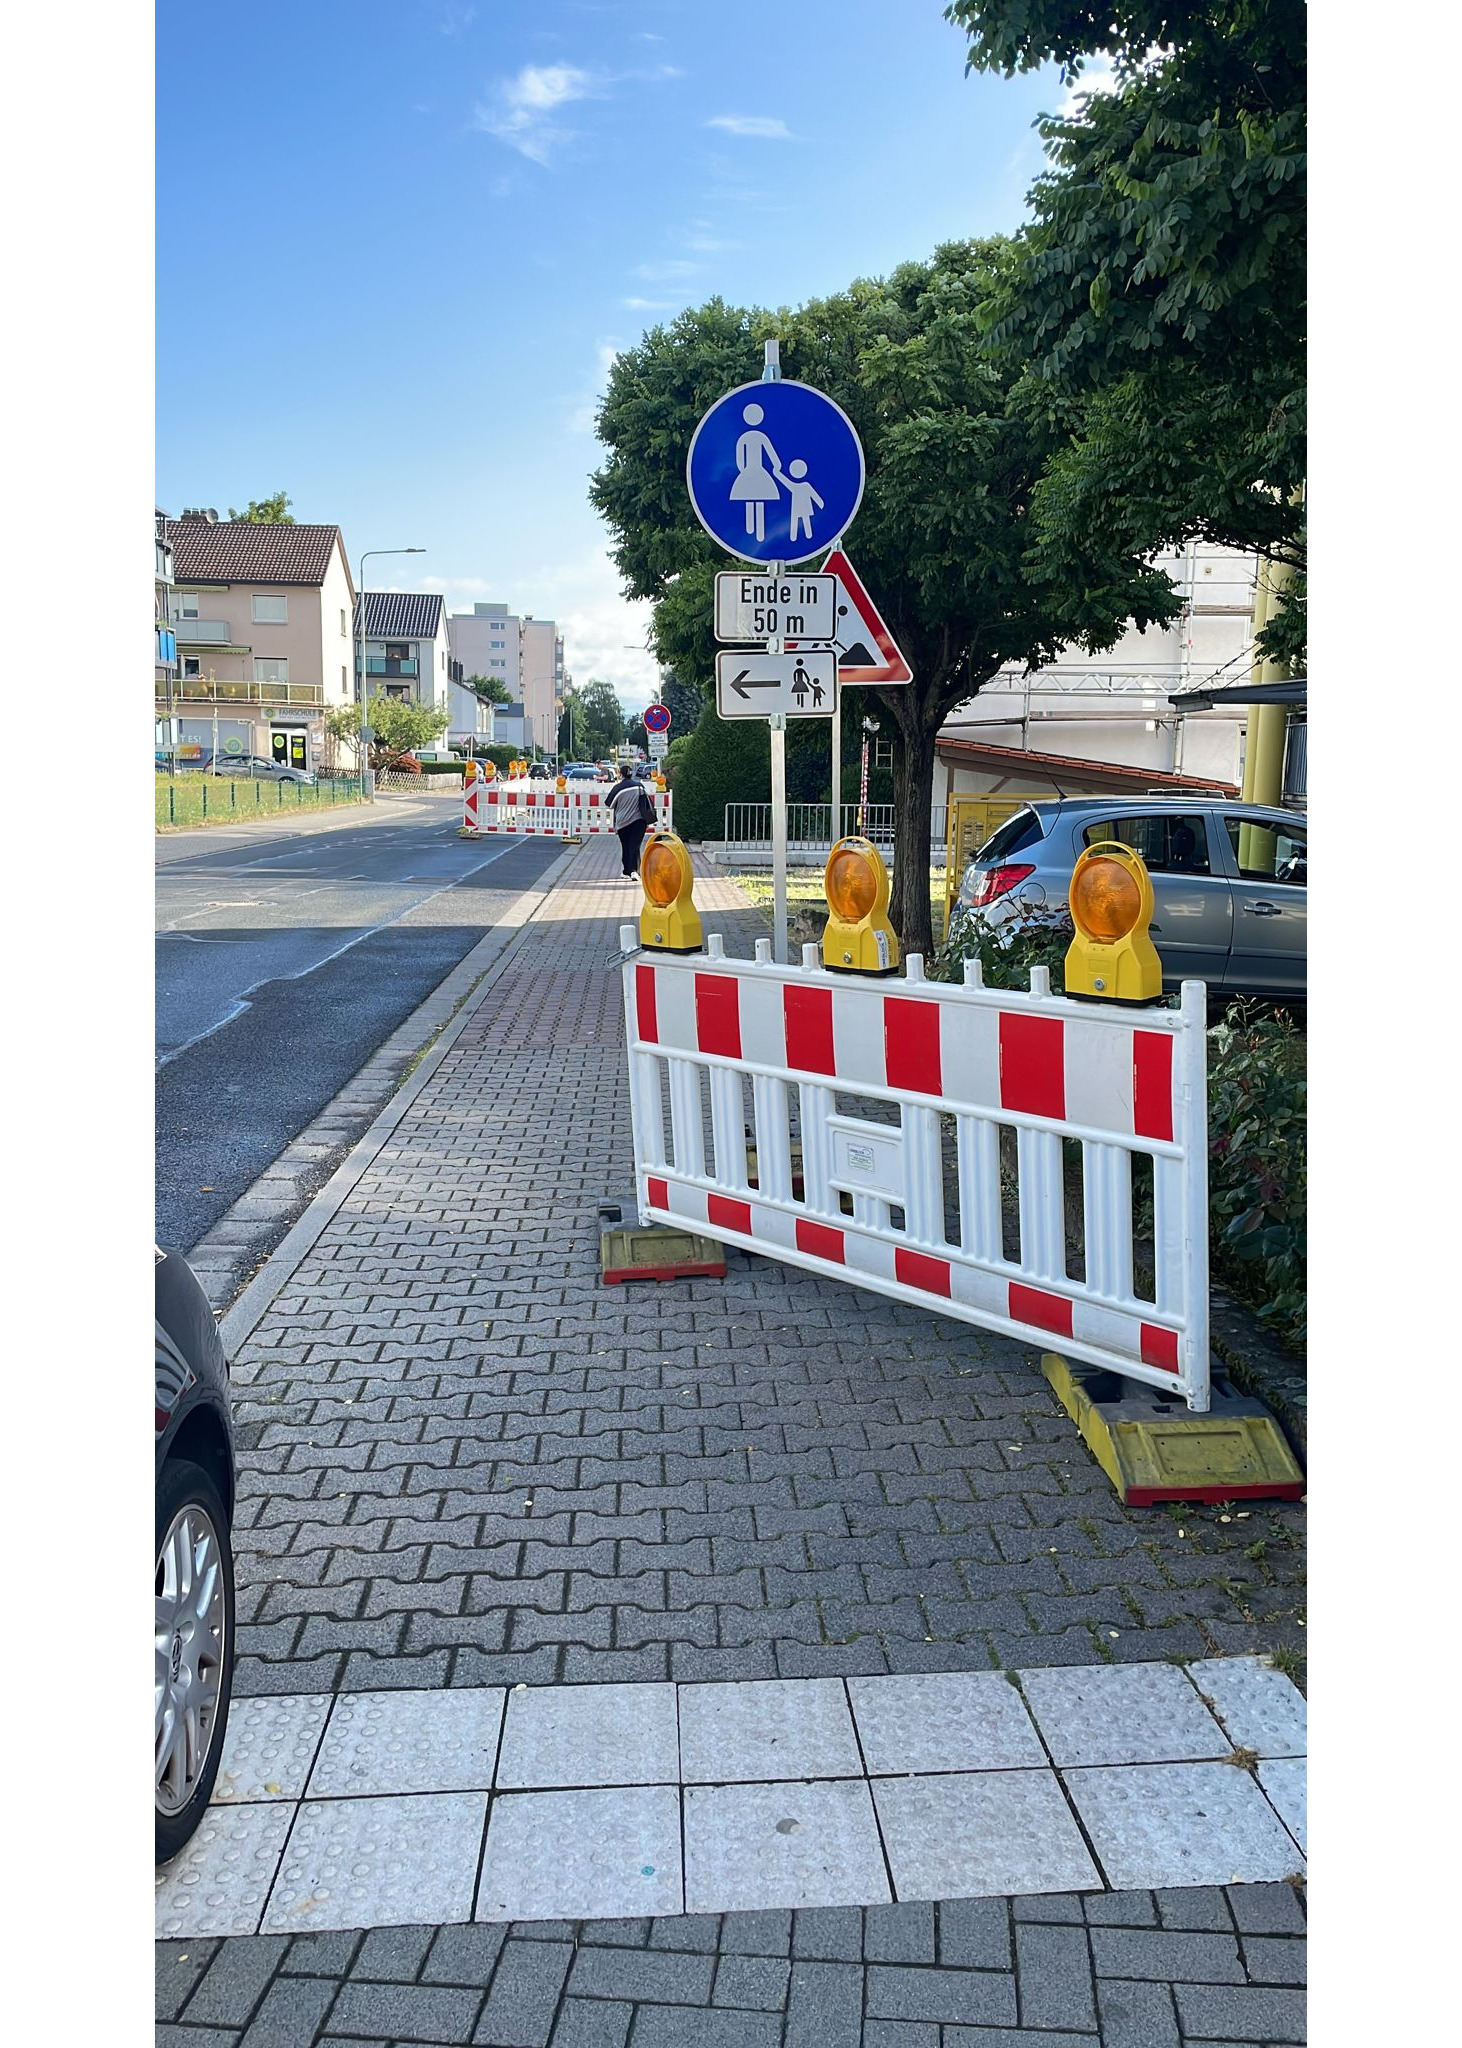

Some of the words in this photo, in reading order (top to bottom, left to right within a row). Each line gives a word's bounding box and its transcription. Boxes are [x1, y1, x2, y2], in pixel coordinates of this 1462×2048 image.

[741, 578, 791, 604] Ende
[799, 579, 818, 604] in
[754, 608, 778, 633] 50
[786, 615, 804, 634] m
